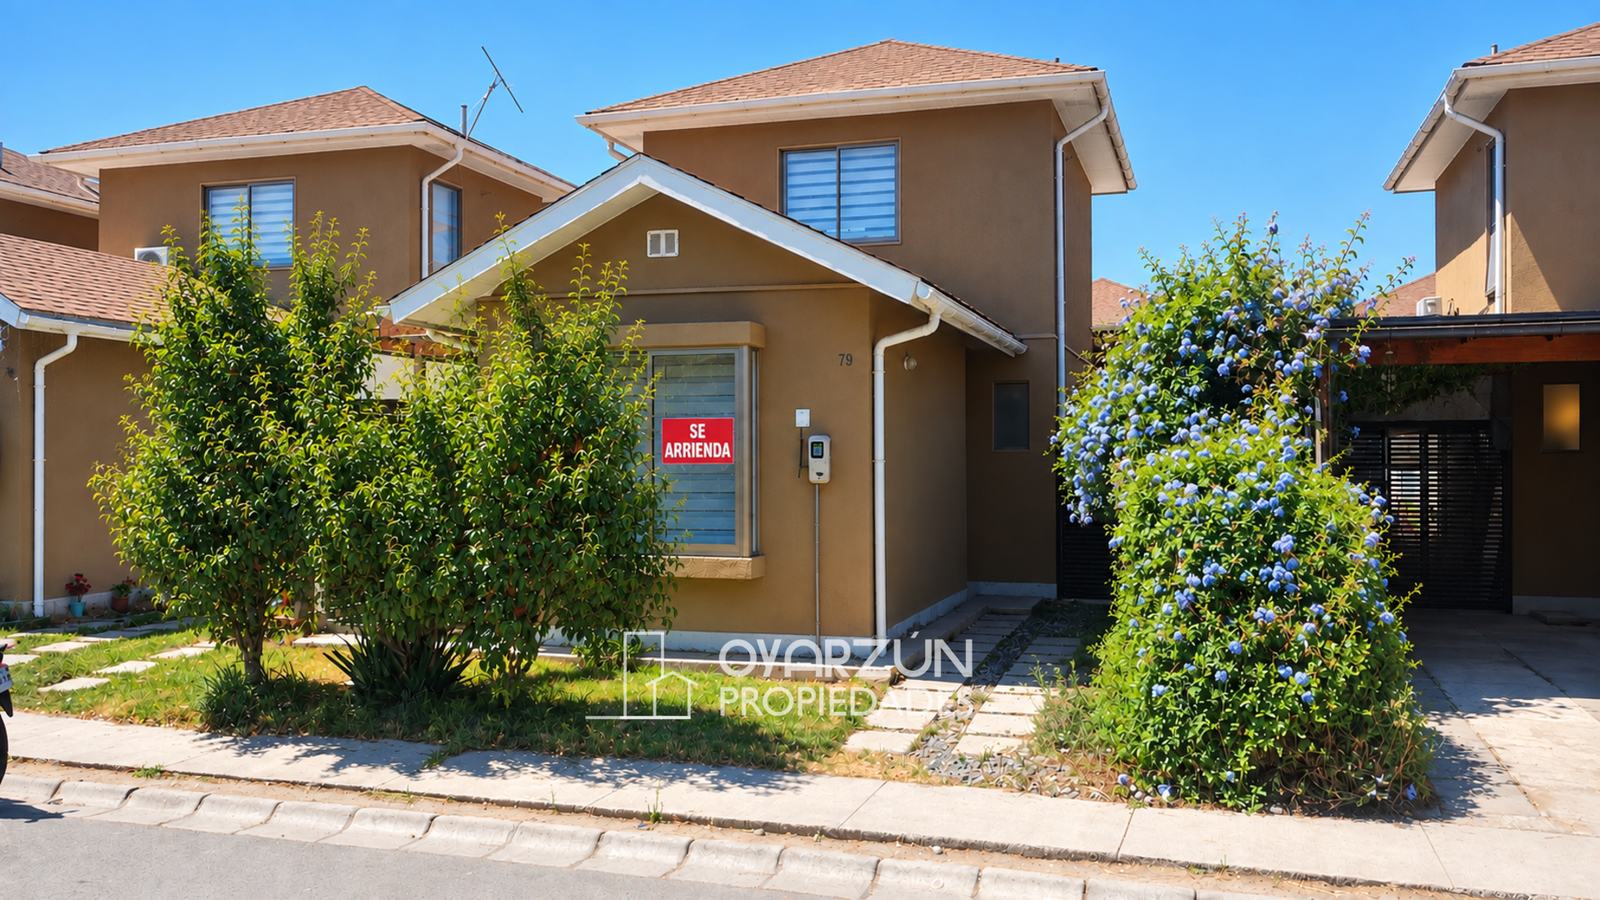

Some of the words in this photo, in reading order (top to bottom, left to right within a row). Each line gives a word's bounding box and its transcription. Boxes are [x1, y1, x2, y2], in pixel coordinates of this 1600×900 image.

[838, 353, 853, 366] 79
[690, 423, 706, 439] SE
[665, 442, 731, 458] ARRIENDA
